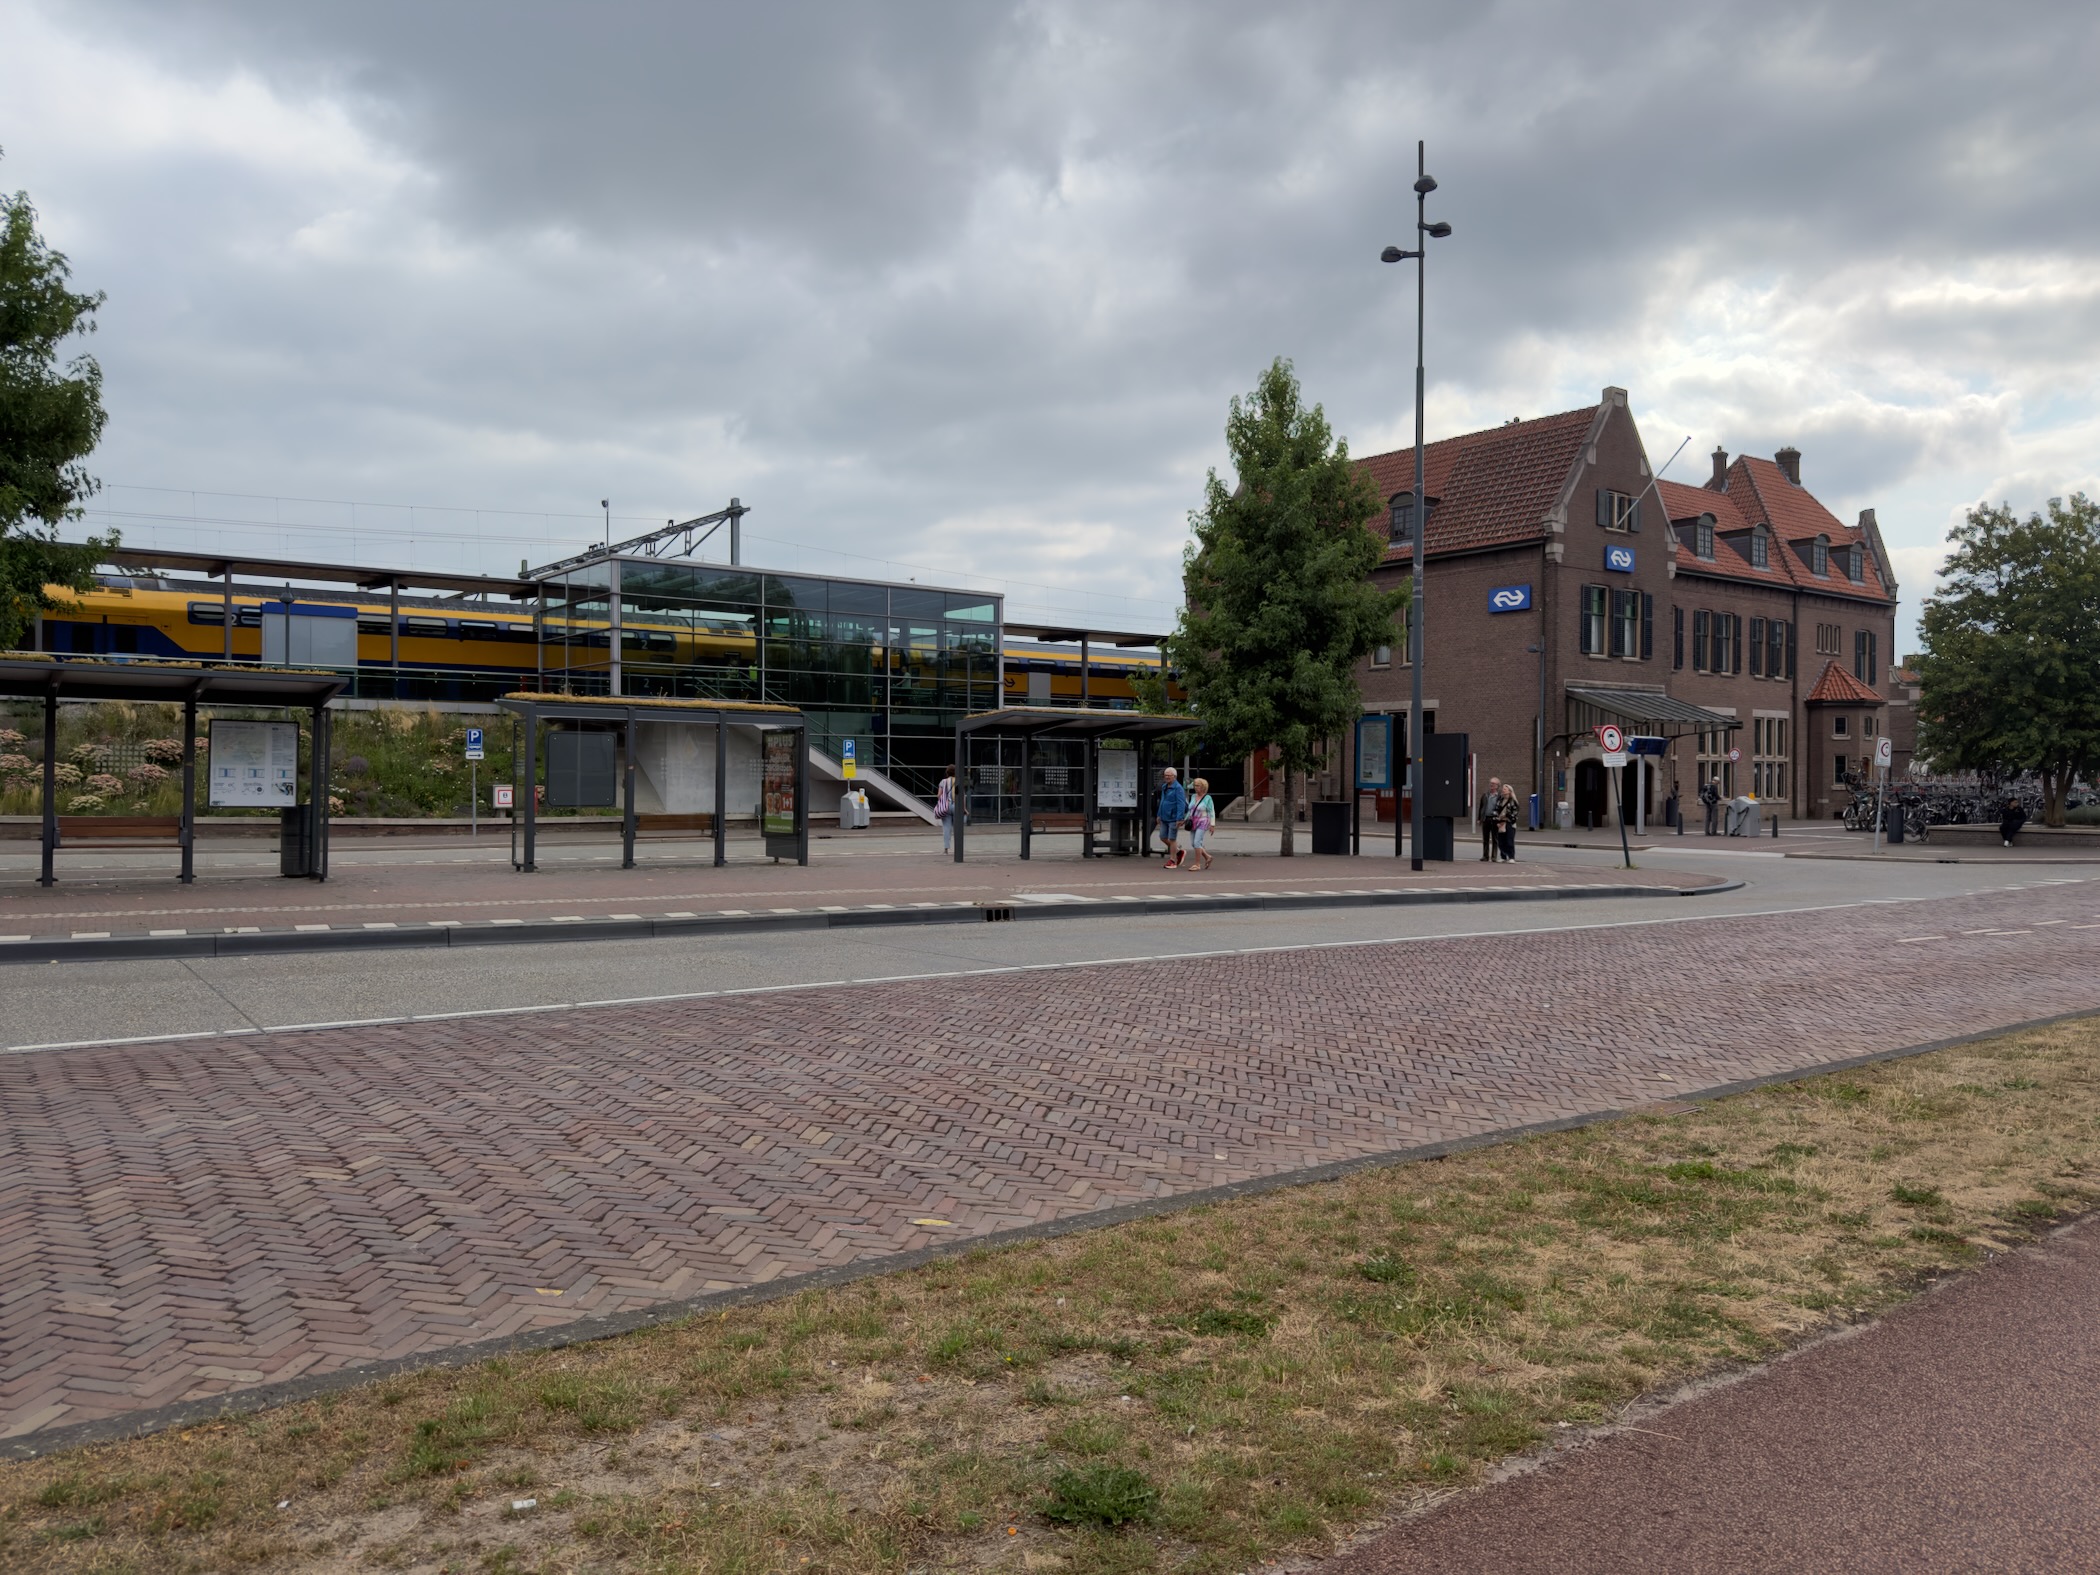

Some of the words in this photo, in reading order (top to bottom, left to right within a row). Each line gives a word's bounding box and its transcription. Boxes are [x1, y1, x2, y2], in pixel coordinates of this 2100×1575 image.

[231, 614, 237, 625] 2
[641, 640, 648, 649] 2
[643, 678, 649, 688] 2
[471, 731, 479, 742] P
[773, 734, 795, 747] PLUS
[846, 742, 852, 751] P
[782, 796, 793, 809] 1+1
